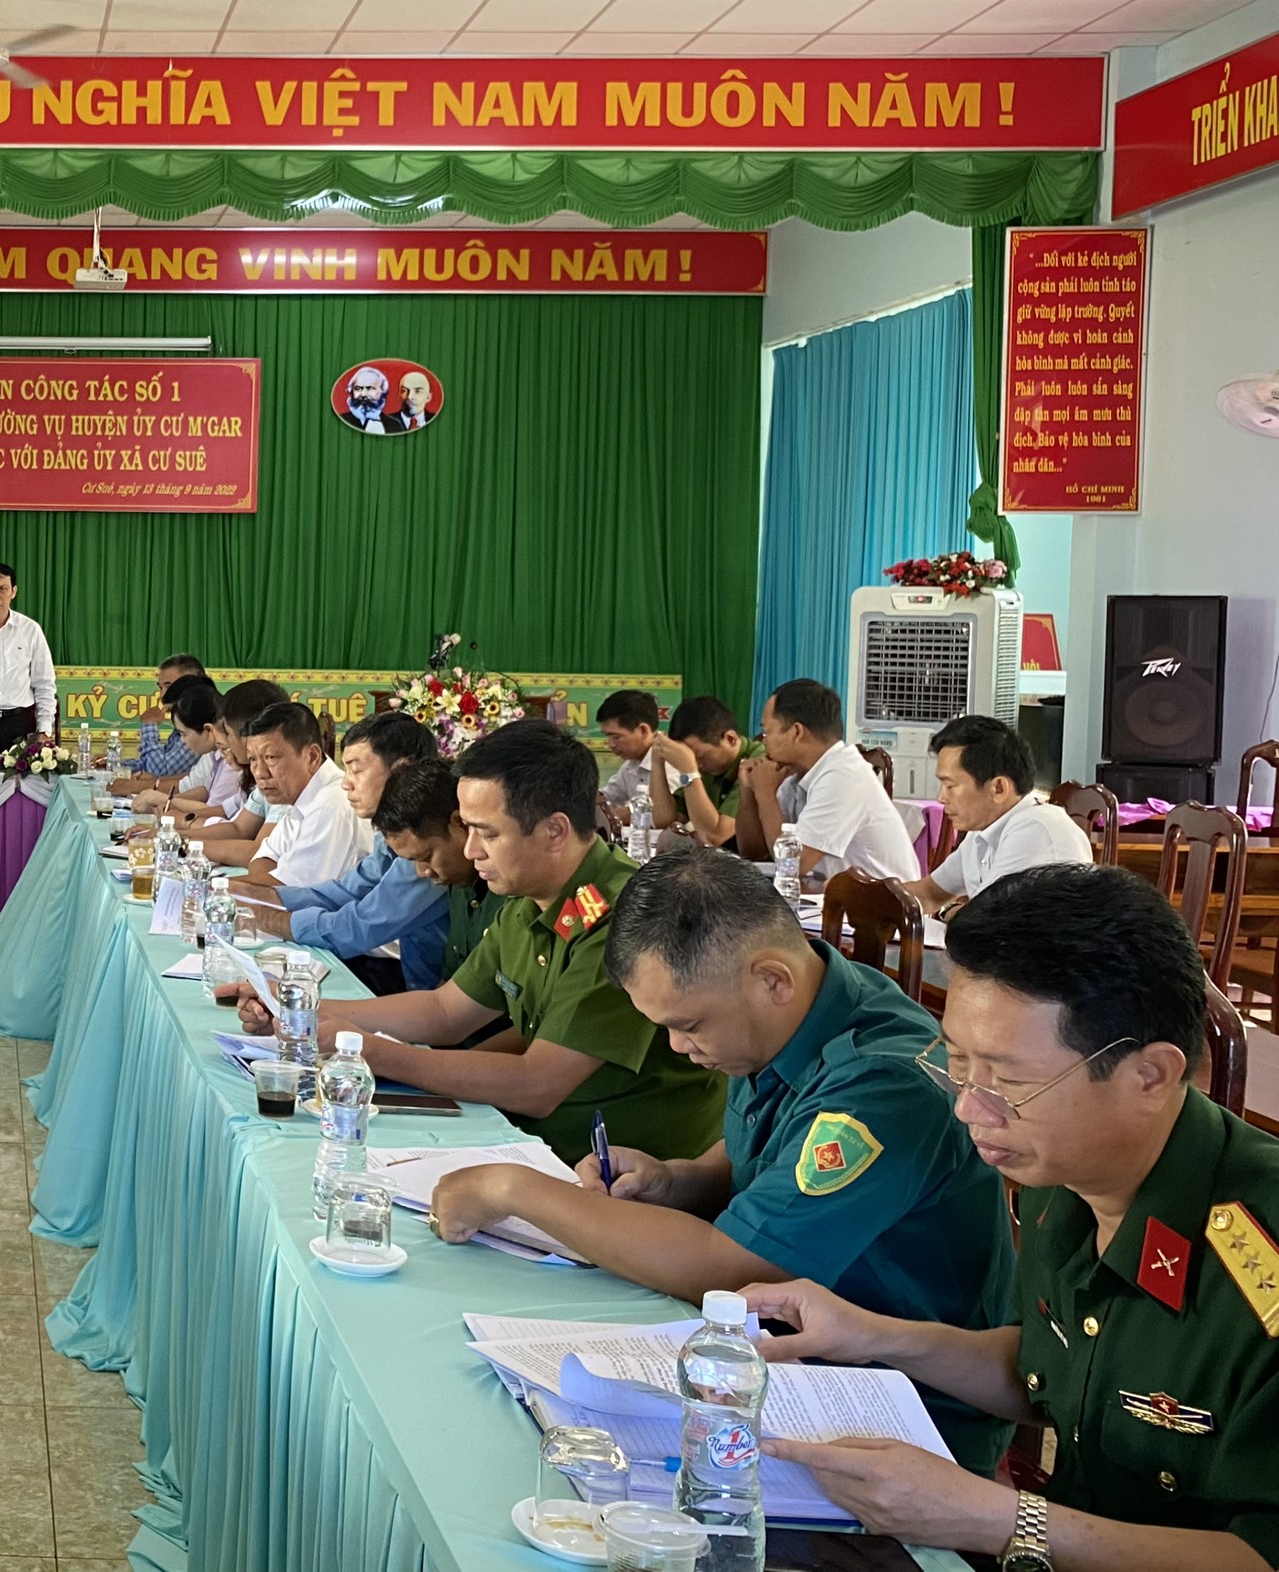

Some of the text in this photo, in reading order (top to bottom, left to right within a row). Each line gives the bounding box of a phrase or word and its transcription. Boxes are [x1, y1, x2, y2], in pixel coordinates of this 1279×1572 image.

[32, 69, 231, 126] NGHĨA
[256, 68, 407, 136] VIỆT
[433, 82, 578, 127] NAM
[606, 70, 805, 127] MUÔN
[828, 73, 981, 127] NĂM
[1191, 62, 1279, 166] TRIỂN KHA
[240, 247, 357, 281] VINH
[377, 240, 529, 281] MUÔN
[551, 241, 664, 281] NĂM
[1062, 250, 1137, 271] với kẻ địch người
[1018, 278, 1039, 298] cộng
[1040, 276, 1056, 293] sản
[1058, 276, 1078, 297] phải
[1080, 277, 1099, 292] luôn
[1122, 277, 1136, 292] táo
[1017, 303, 1032, 324] giữ
[1035, 303, 1056, 323] vững
[1058, 303, 1072, 323] lập
[1108, 300, 1135, 322] Quyết
[1016, 327, 1134, 349] không được vì hoàn cảnh
[1015, 355, 1032, 370] hòa
[1033, 354, 1054, 370] bình
[1055, 354, 1069, 370] mà
[1070, 352, 1088, 370] mất
[1090, 352, 1112, 370] cảnh
[20, 374, 79, 401] CÔNG
[85, 374, 128, 401] TÁC
[134, 371, 164, 402] SỐ
[171, 381, 181, 402] 1
[1015, 379, 1133, 400] Phải luôn luôn sàng
[42, 414, 65, 440] VỤ
[70, 409, 127, 441] HUYỆN
[133, 407, 156, 437] ỦY
[160, 411, 185, 437] CƯ
[187, 415, 243, 438] M'GAR
[1014, 406, 1031, 426] đập
[1052, 406, 1070, 424] mọi
[1074, 406, 1088, 421] âm
[1092, 408, 1112, 421] mưu
[1116, 405, 1132, 421] thù
[1038, 430, 1131, 450] Bảo vệ hòa bình của
[9, 442, 38, 470] VỚI
[42, 442, 88, 471] ĐẢNG
[93, 442, 116, 471] ỦY
[119, 445, 144, 471] XÃ
[148, 446, 172, 471] CƯ
[175, 445, 207, 472] SUÊ
[1013, 457, 1036, 473] nhân
[81, 482, 238, 498] Cư ngày 13 tháng 9 năm 2022
[67, 685, 108, 719] KỶ
[708, 1434, 752, 1454] Number
